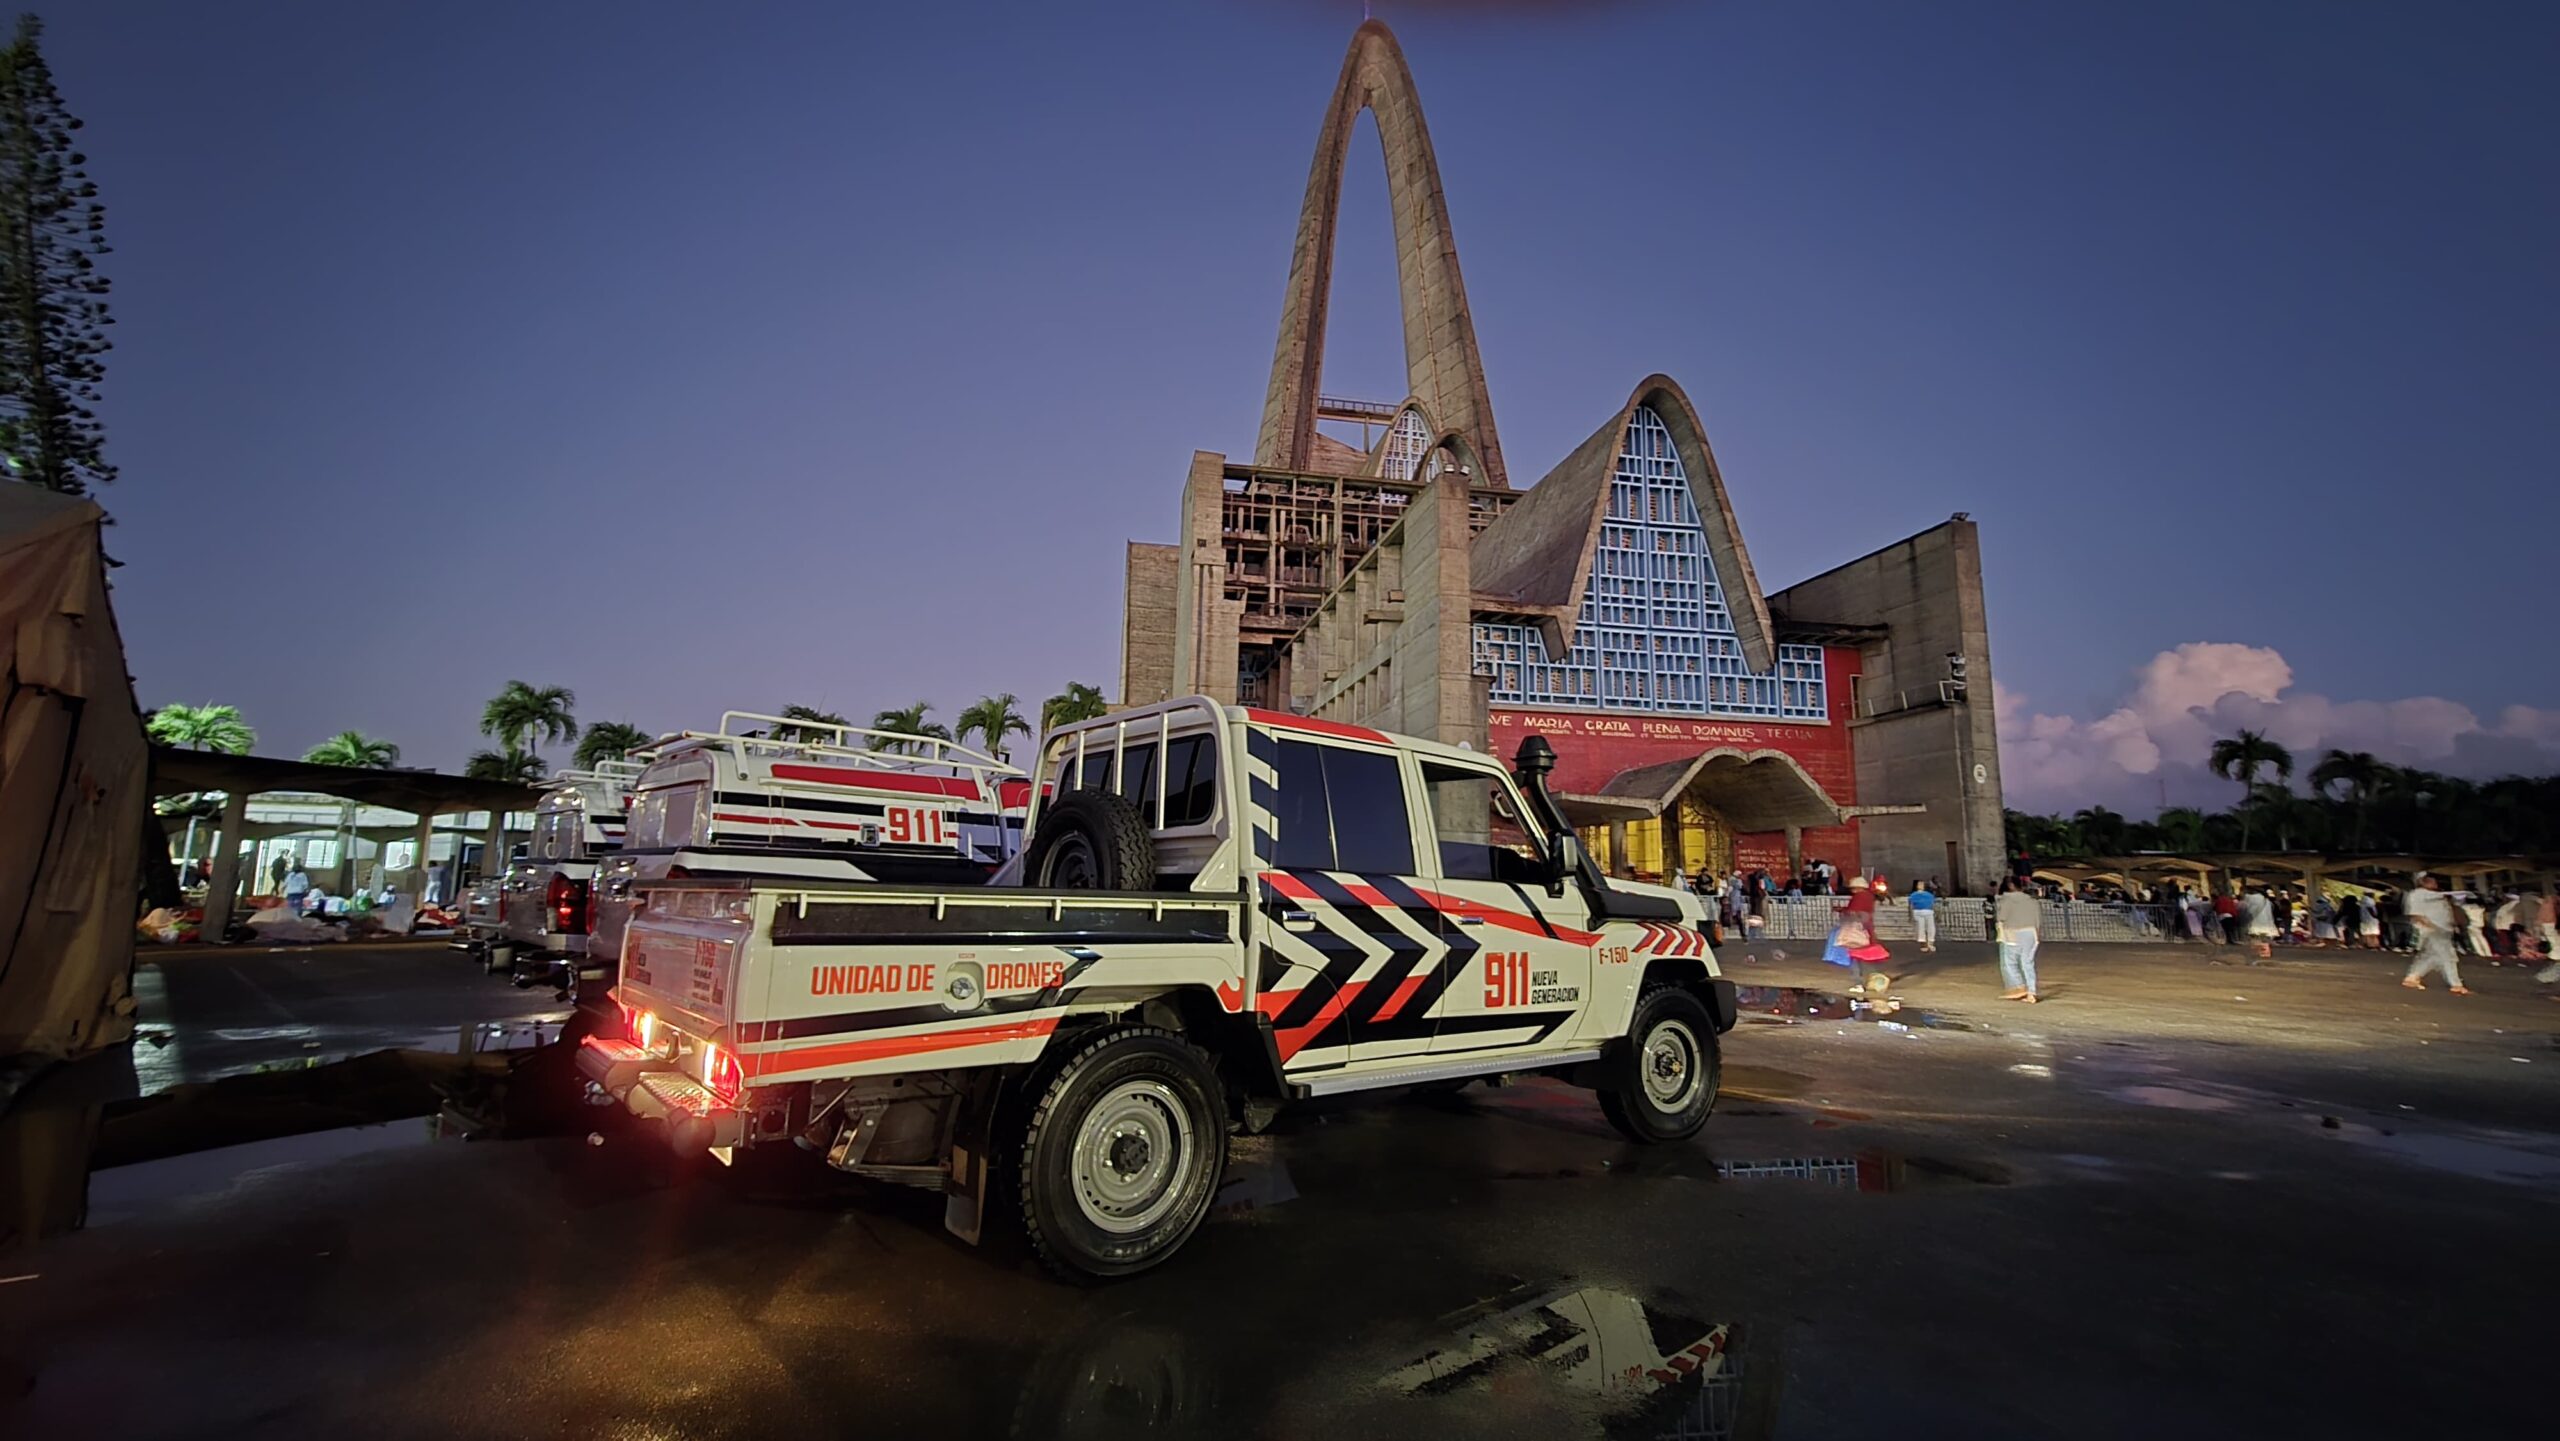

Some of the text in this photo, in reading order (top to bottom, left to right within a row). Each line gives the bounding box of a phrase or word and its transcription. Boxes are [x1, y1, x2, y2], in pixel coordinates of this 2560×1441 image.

[1523, 716, 1573, 730] MARIA
[1642, 722, 1682, 735] PLENA
[1692, 724, 1755, 738] DOMINUS
[887, 806, 942, 844] 911
[1599, 946, 1628, 964] F-150
[811, 961, 1064, 996] UNIDAD DE DRONES
[1484, 951, 1529, 1008] 911
[1531, 970, 1558, 987] NUEVA
